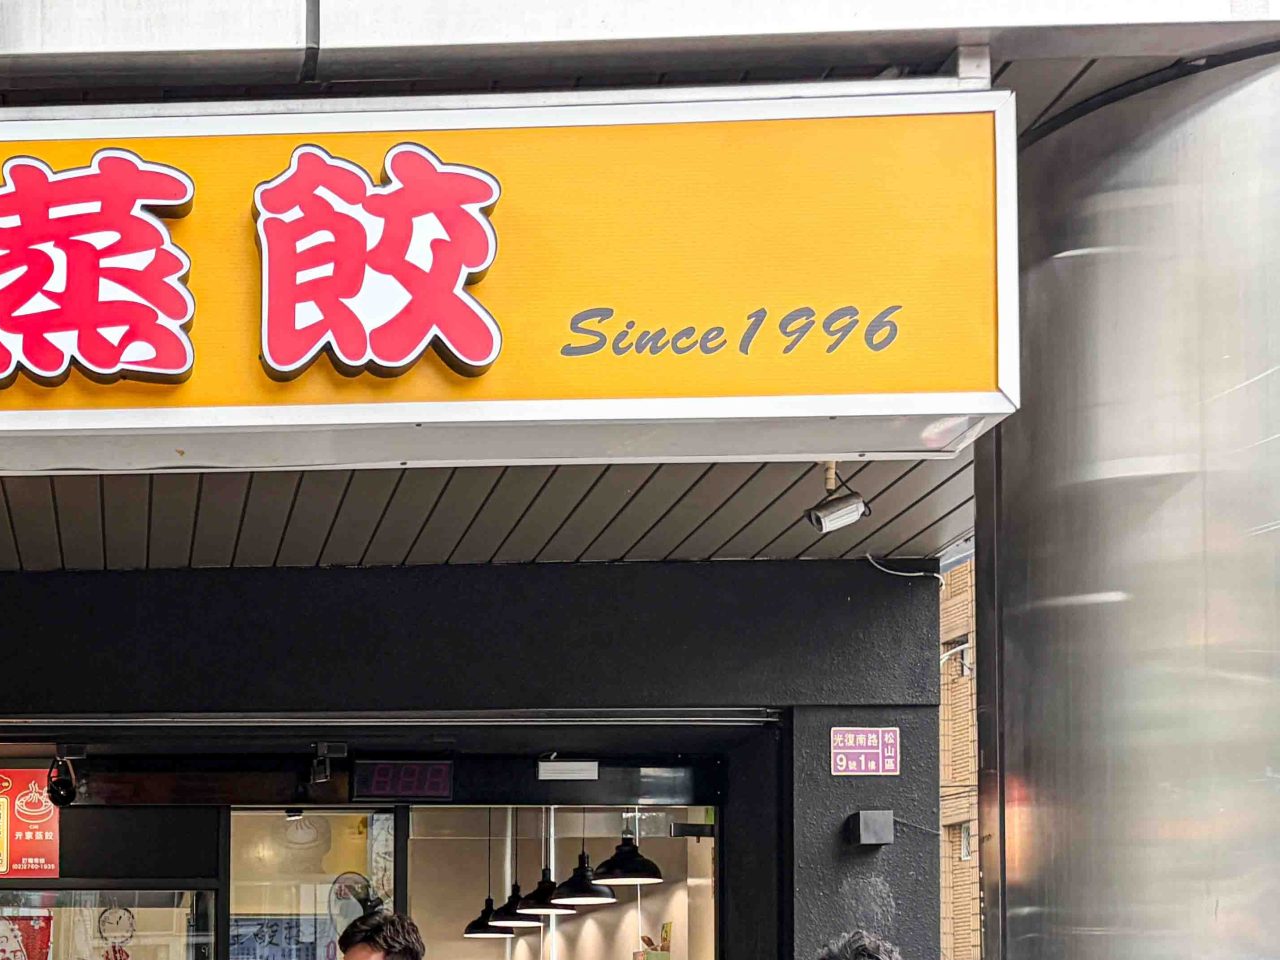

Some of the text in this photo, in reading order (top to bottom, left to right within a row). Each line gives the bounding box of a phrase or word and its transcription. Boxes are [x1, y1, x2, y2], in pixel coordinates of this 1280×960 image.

[833, 733, 878, 747] 光復南路
[884, 732, 895, 770] 松山區
